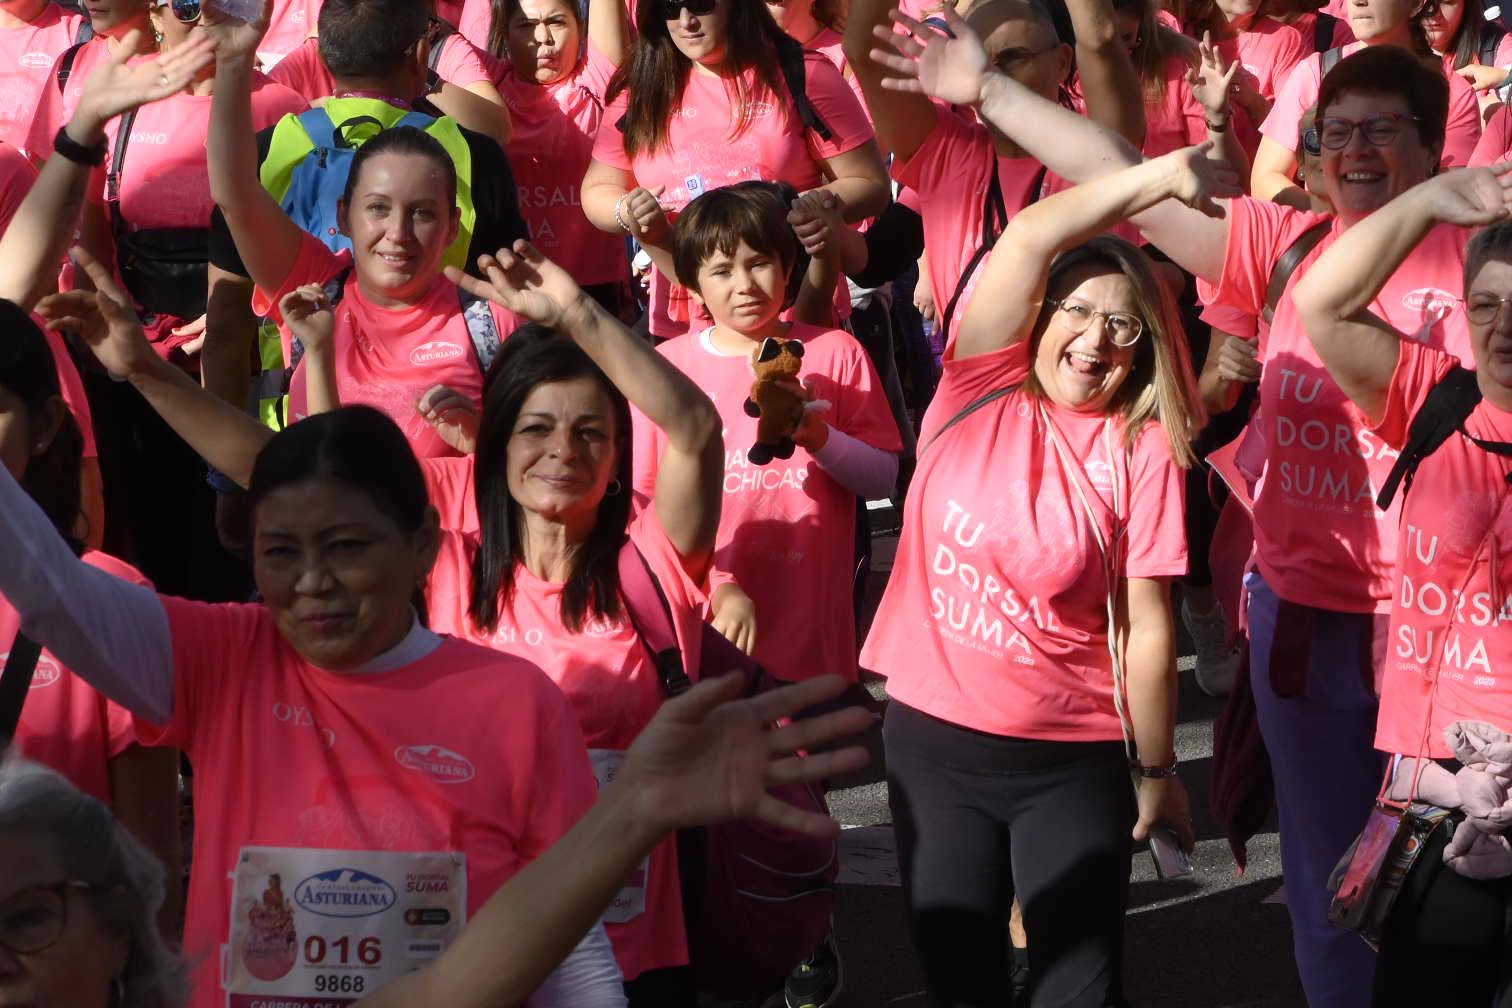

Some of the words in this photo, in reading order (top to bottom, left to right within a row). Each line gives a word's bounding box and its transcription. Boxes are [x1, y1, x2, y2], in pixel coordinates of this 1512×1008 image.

[517, 184, 581, 208] RSAL
[414, 347, 461, 363] ASTURIANA
[1279, 368, 1324, 404] TU
[1276, 415, 1401, 462] DORSA
[722, 468, 809, 493] CHICAS
[1280, 461, 1378, 503] SUMA
[941, 499, 985, 548] TU
[1405, 524, 1439, 566] TU
[932, 543, 1061, 632] DORSAL
[930, 587, 1034, 655] SUMA
[1396, 624, 1492, 673] SUMA
[272, 701, 336, 748] OYSO
[302, 886, 388, 907] ASTURIANA
[406, 881, 450, 893] SUMA
[304, 935, 383, 965] 016
[314, 974, 365, 993] 9868
